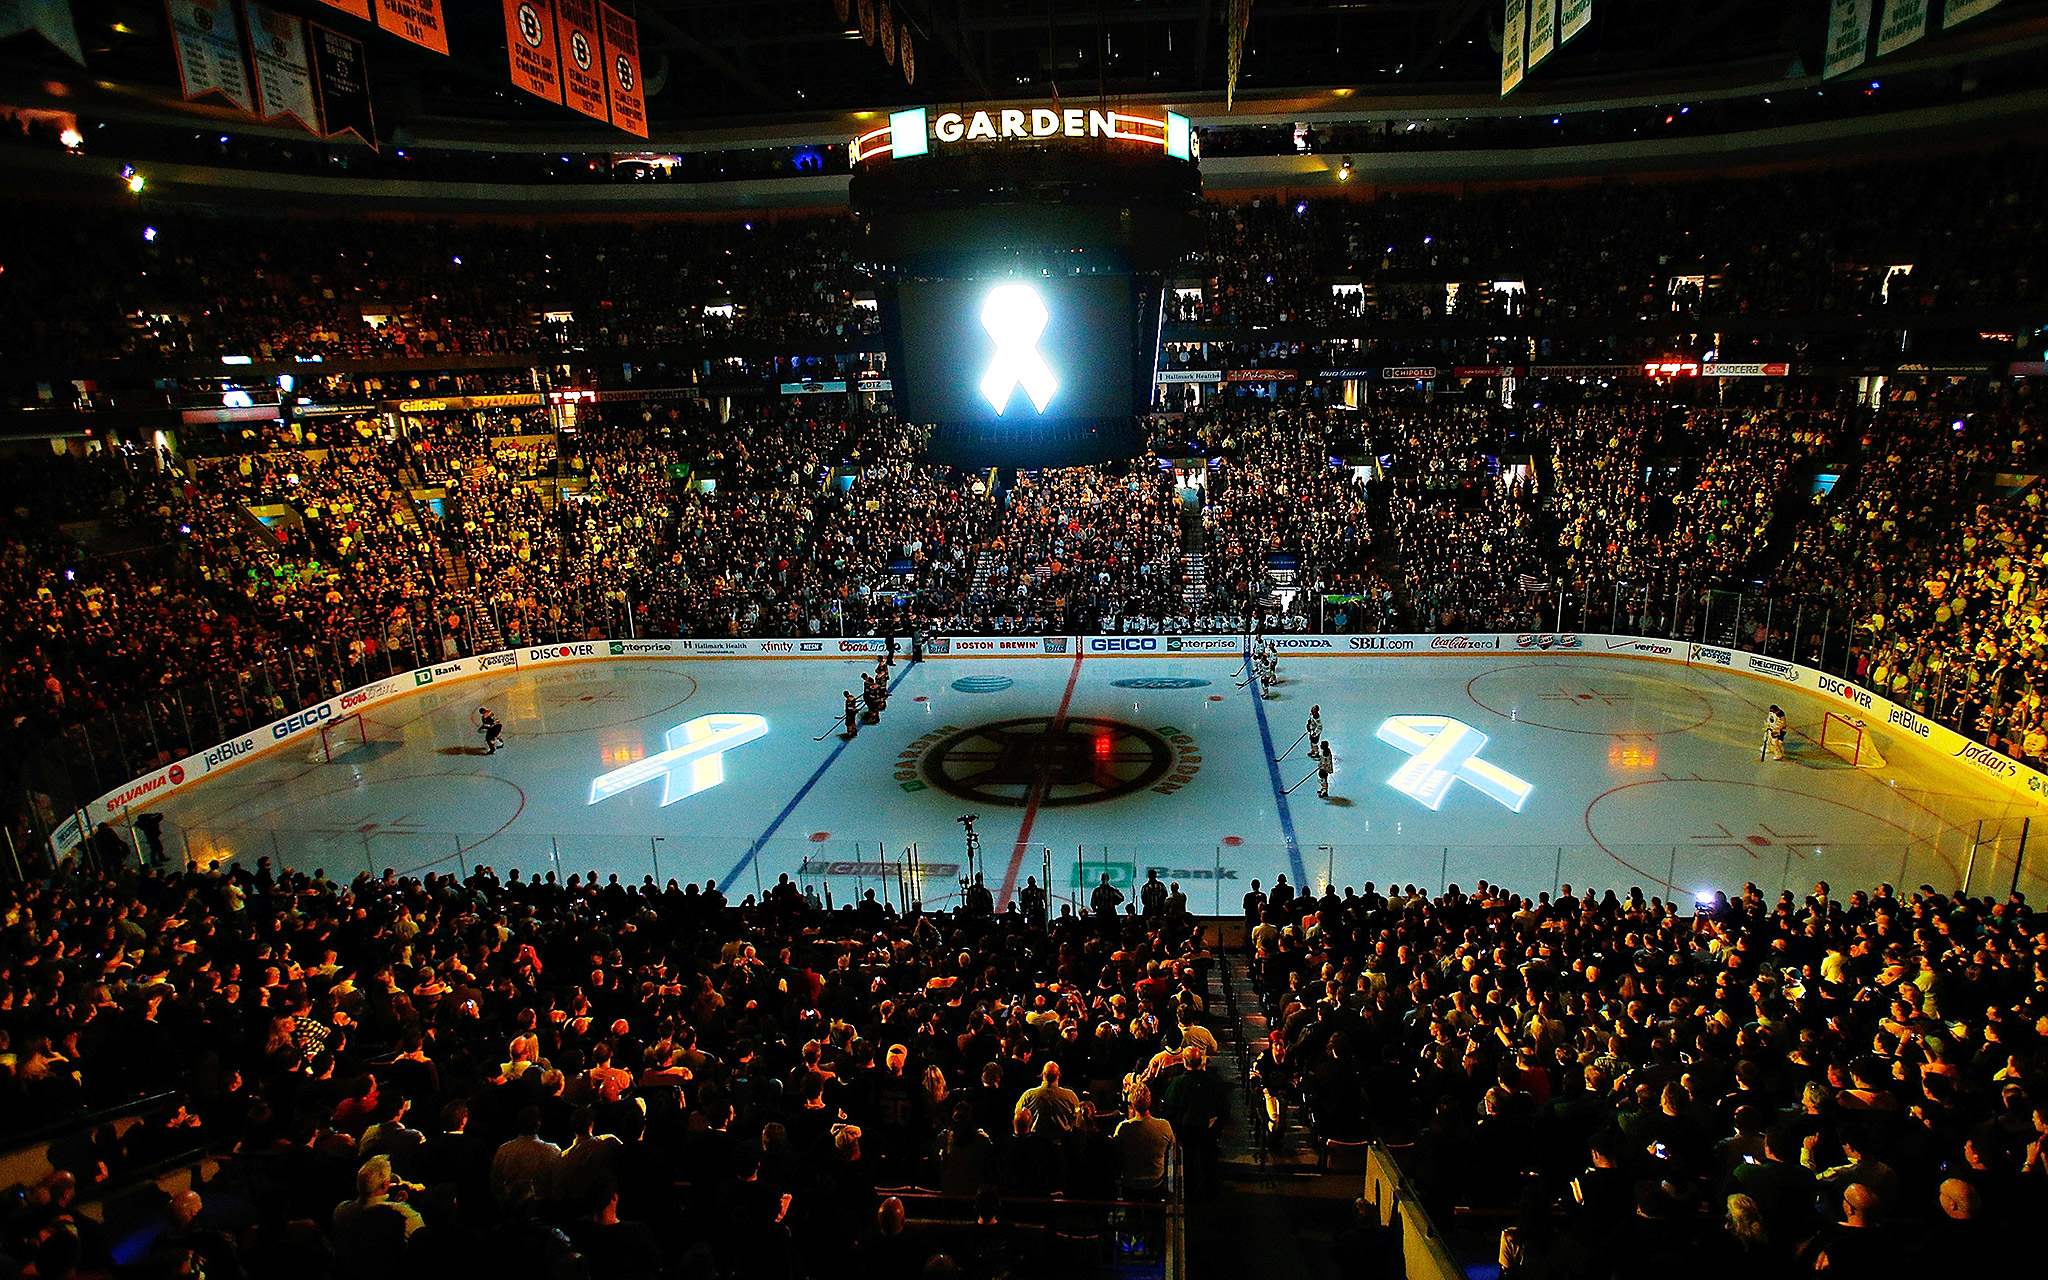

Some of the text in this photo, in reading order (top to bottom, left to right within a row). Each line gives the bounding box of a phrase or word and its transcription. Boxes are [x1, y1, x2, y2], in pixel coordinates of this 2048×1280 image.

[384, 1, 437, 31] CHAMPIONS
[404, 21, 424, 41] 1941
[935, 108, 1116, 143] GARDEN
[1716, 365, 1759, 374] KYOCERA
[400, 400, 446, 412] Gillette
[472, 394, 540, 408] SYLVANIA
[615, 642, 671, 653] enterprise
[760, 641, 794, 653] xfinity
[838, 640, 868, 652] Coors
[1092, 638, 1156, 651] GEICO
[1171, 639, 1236, 650] enterprise
[1276, 639, 1332, 648] HONDA
[1349, 637, 1414, 650] SBLI.com
[1468, 641, 1493, 649] zero
[1634, 642, 1672, 655] verizon
[530, 644, 594, 661] DISCOVER
[1701, 651, 1731, 661] BOSTON
[416, 663, 461, 683] TD Bank
[1751, 658, 1763, 668] THE
[1763, 660, 1789, 674] LOTTERY
[1818, 676, 1873, 709] DISCOVER
[340, 692, 367, 710] Coors
[272, 703, 332, 740] GEICO
[1888, 705, 1930, 738] jetBlue
[204, 738, 254, 772] jetBlue
[1949, 741, 2017, 777] Jordan's
[106, 775, 167, 813] SYLVANIA
[834, 862, 951, 874] CHIPLE
[1146, 866, 1239, 880] Bank
